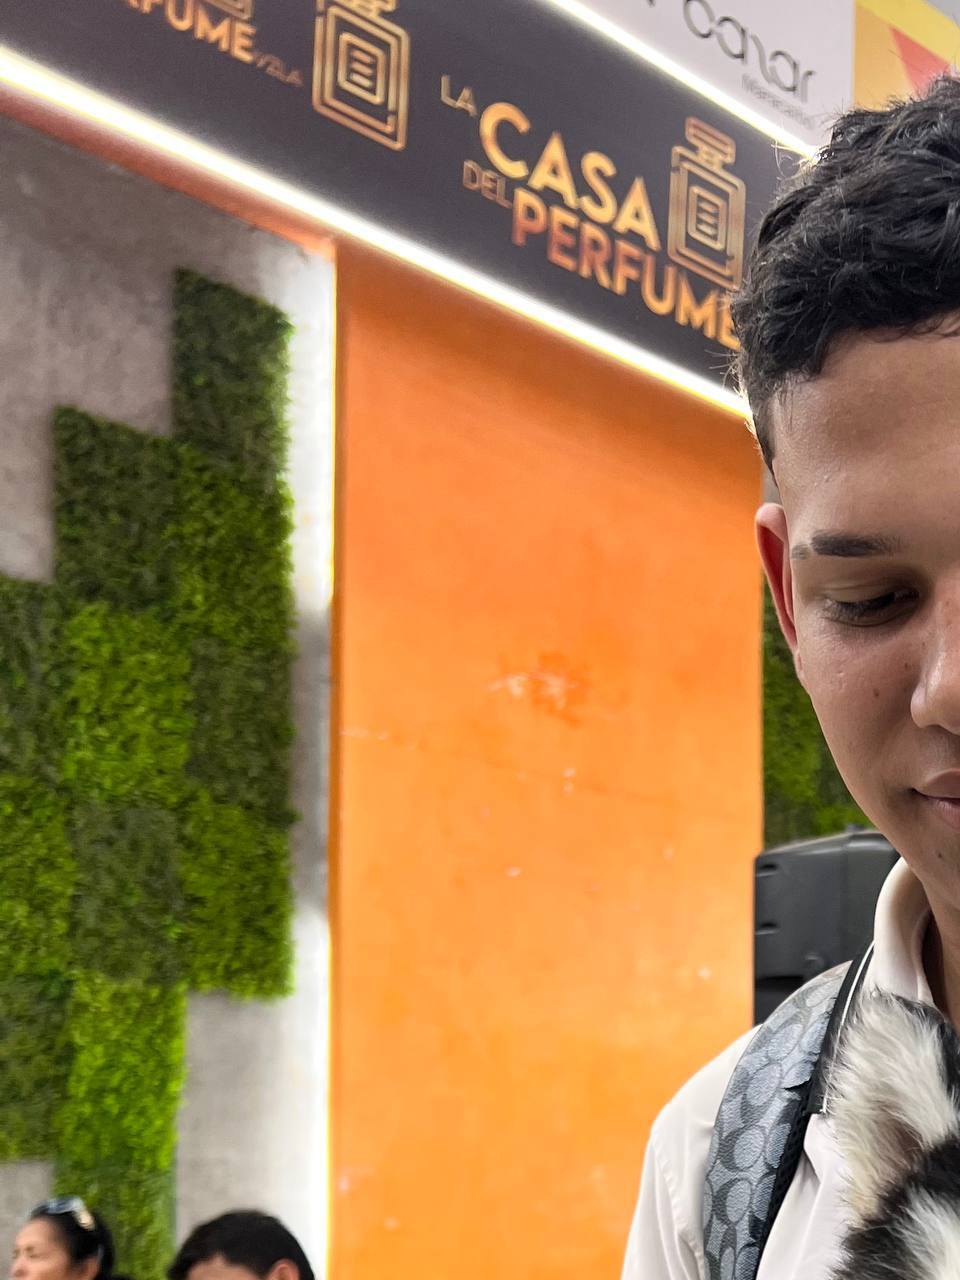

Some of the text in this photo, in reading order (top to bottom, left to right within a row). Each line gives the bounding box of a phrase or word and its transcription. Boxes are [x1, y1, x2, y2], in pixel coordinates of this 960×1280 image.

[441, 75, 662, 252] LA CASA
[462, 159, 514, 209] DEL
